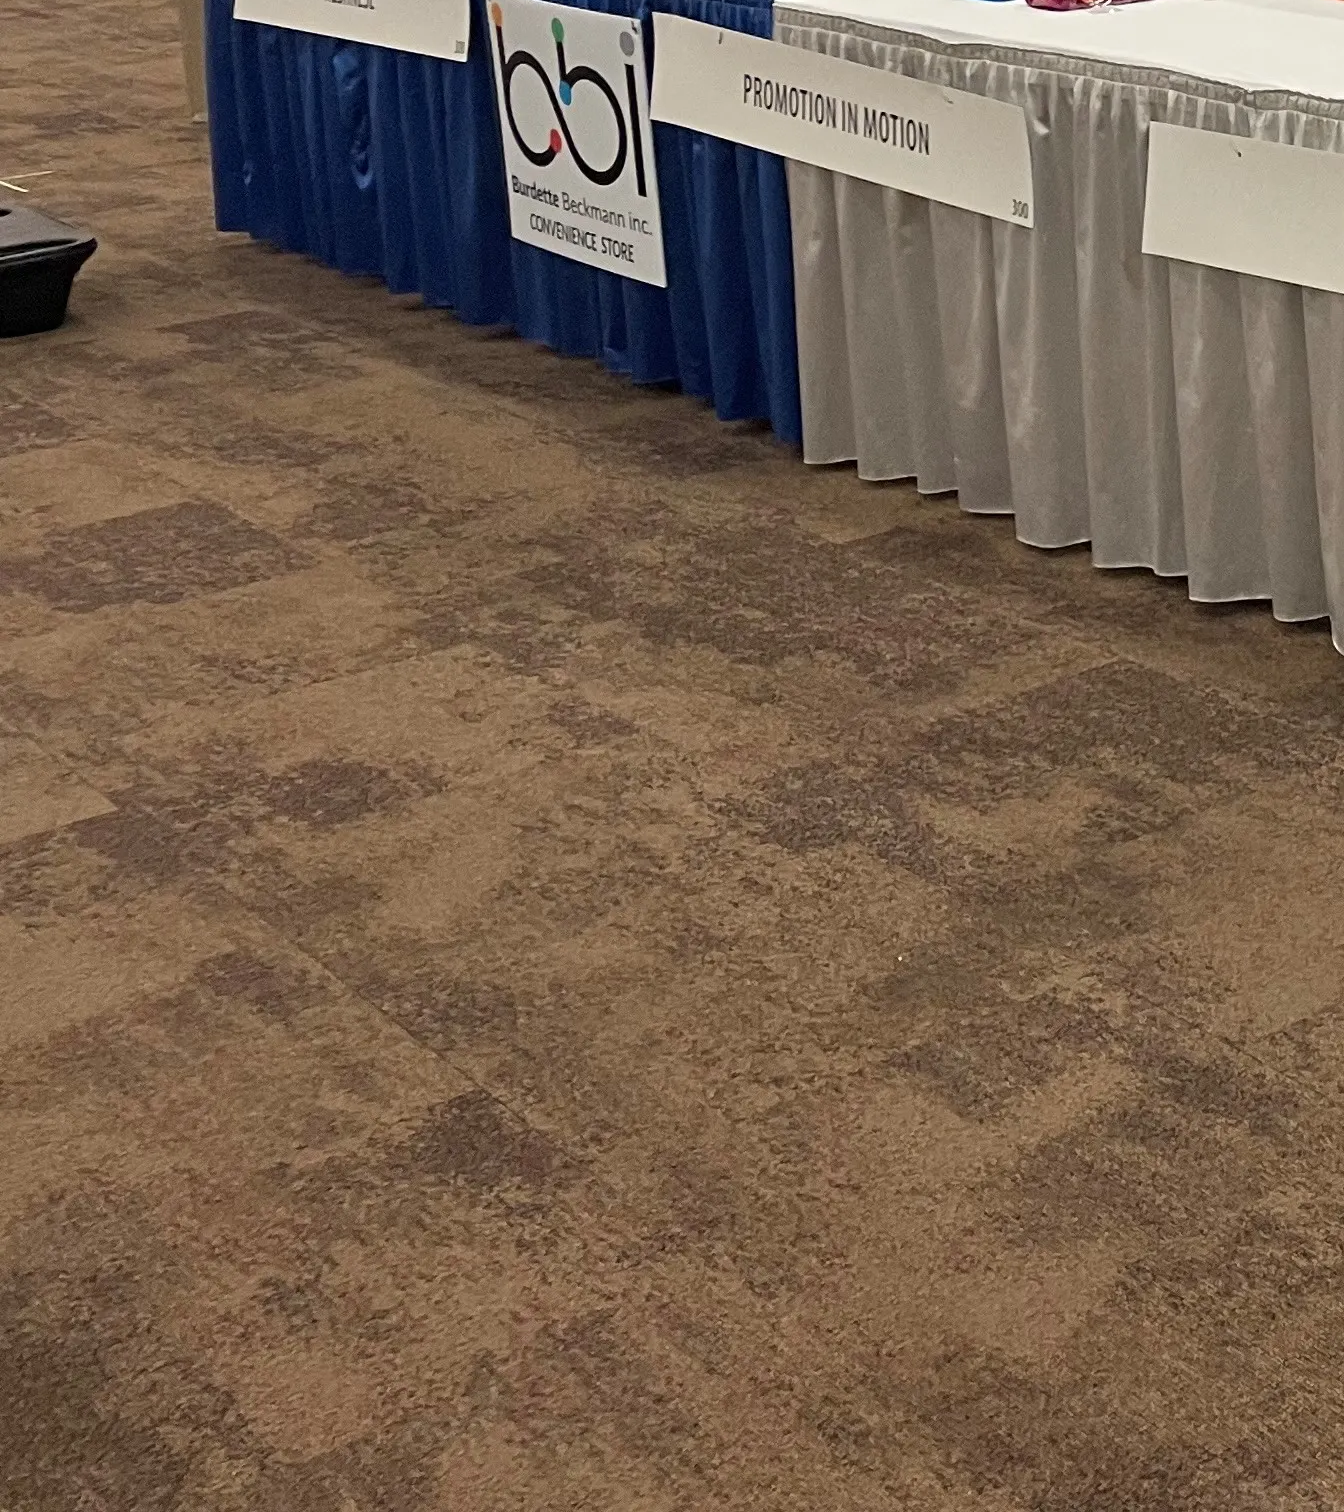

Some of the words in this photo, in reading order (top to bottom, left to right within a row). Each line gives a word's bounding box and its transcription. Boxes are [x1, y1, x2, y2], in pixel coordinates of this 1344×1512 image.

[743, 73, 837, 130] PROMOTION
[840, 99, 859, 135] IN
[862, 112, 930, 156] MOTION
[511, 174, 560, 208] Burdette
[561, 191, 626, 228] Beckmann
[627, 212, 653, 236] inc.
[1011, 198, 1029, 220] 300
[529, 213, 598, 252] CONVENIENCE
[601, 236, 635, 263] STORE
